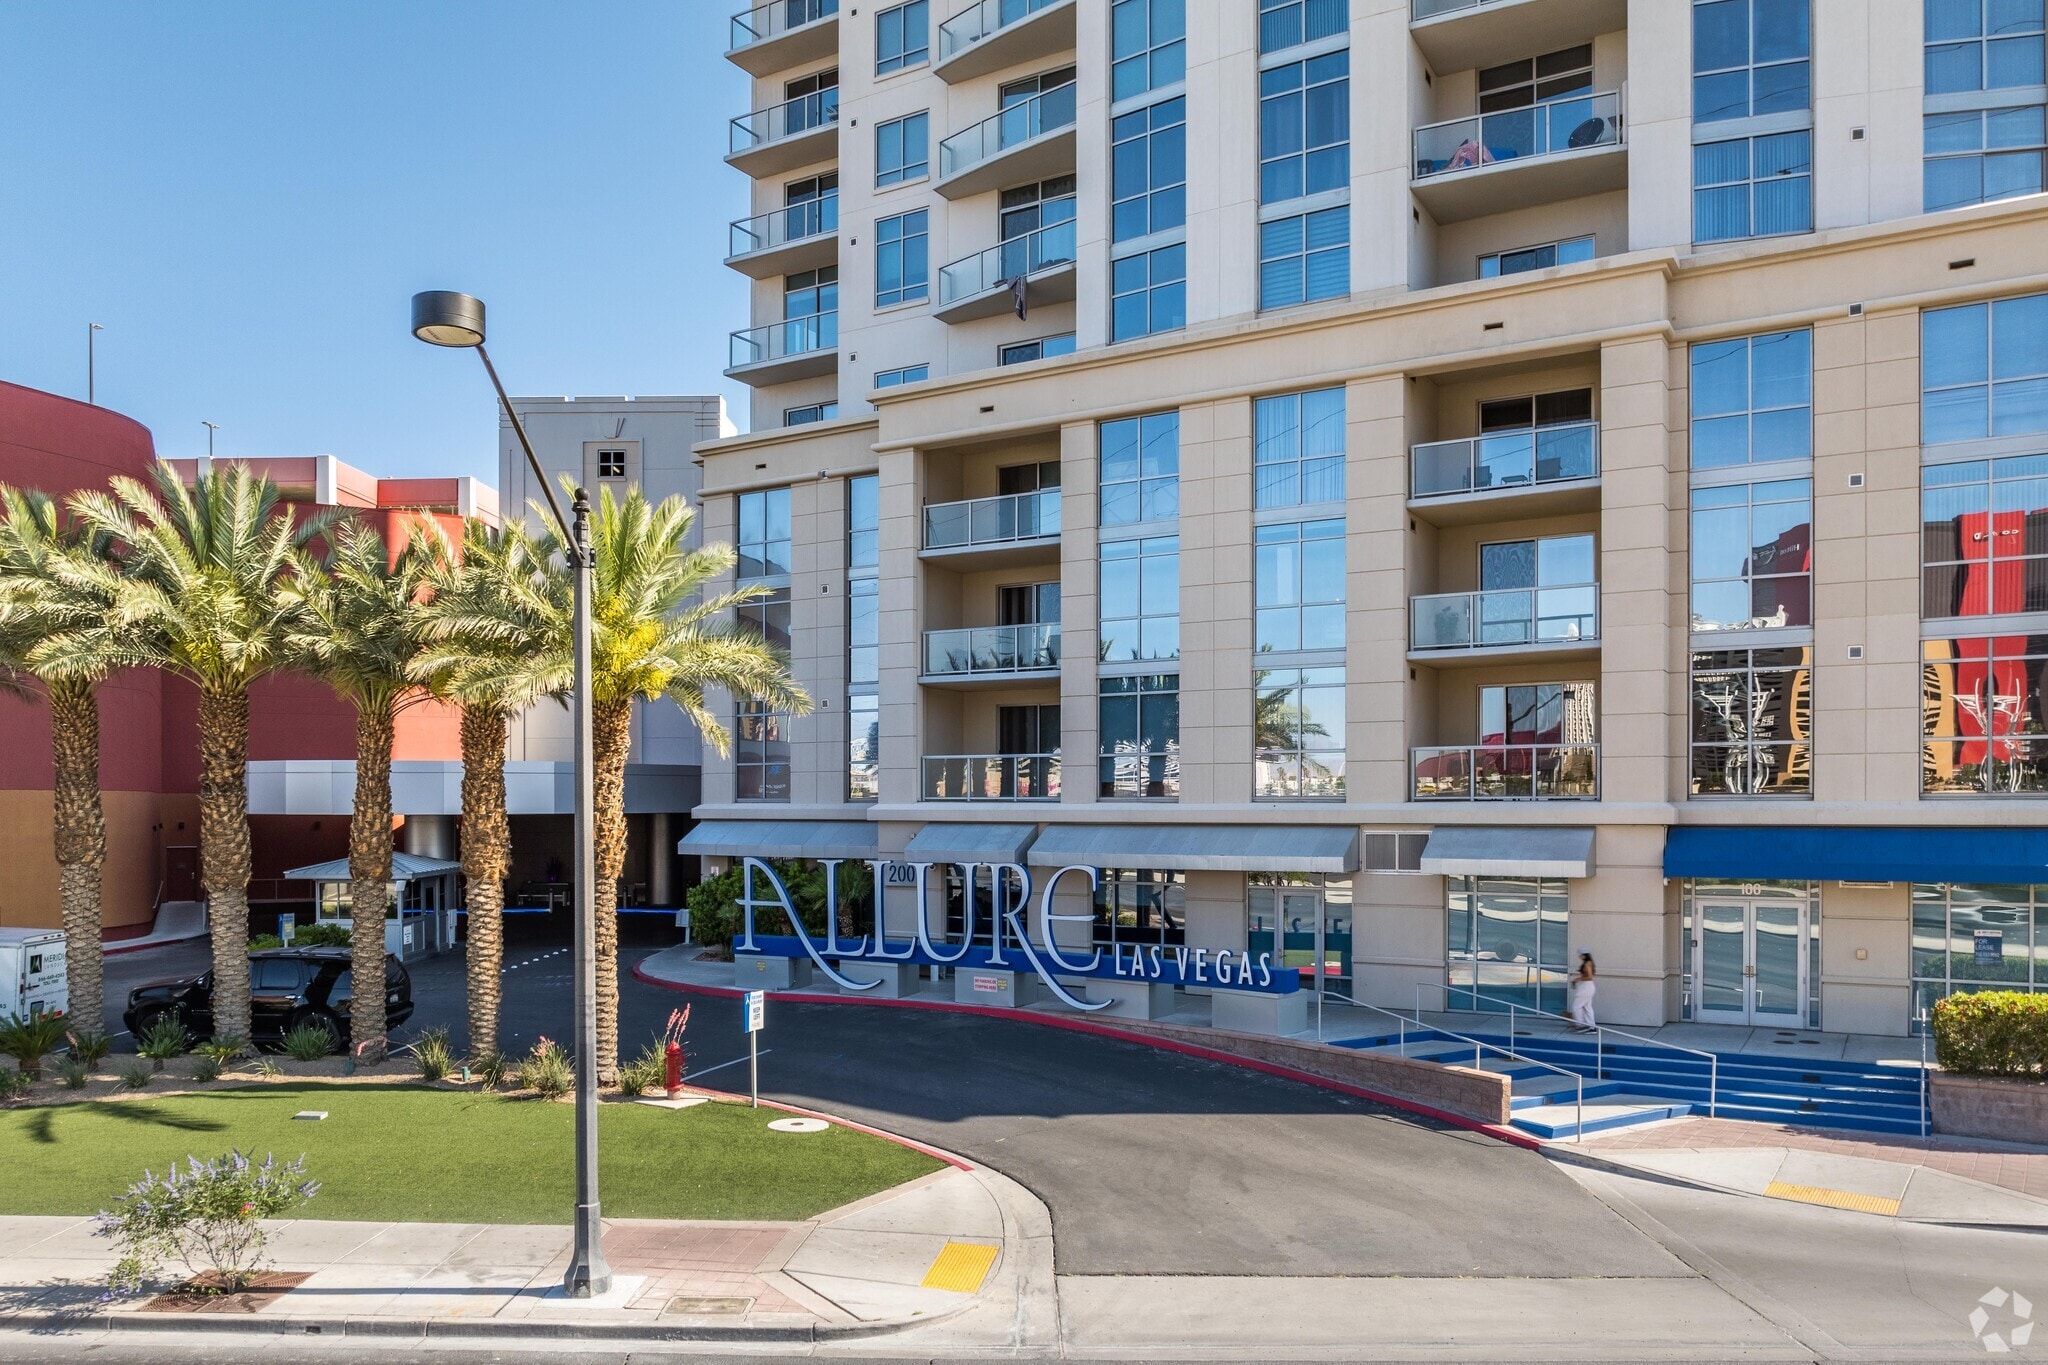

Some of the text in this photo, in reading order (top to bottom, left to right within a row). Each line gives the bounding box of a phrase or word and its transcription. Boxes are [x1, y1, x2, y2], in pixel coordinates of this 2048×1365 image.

[889, 865, 915, 882] 200
[1741, 883, 1761, 895] 100
[735, 857, 1114, 1011] ALLURE
[1115, 943, 1272, 987] LAS VEGAS
